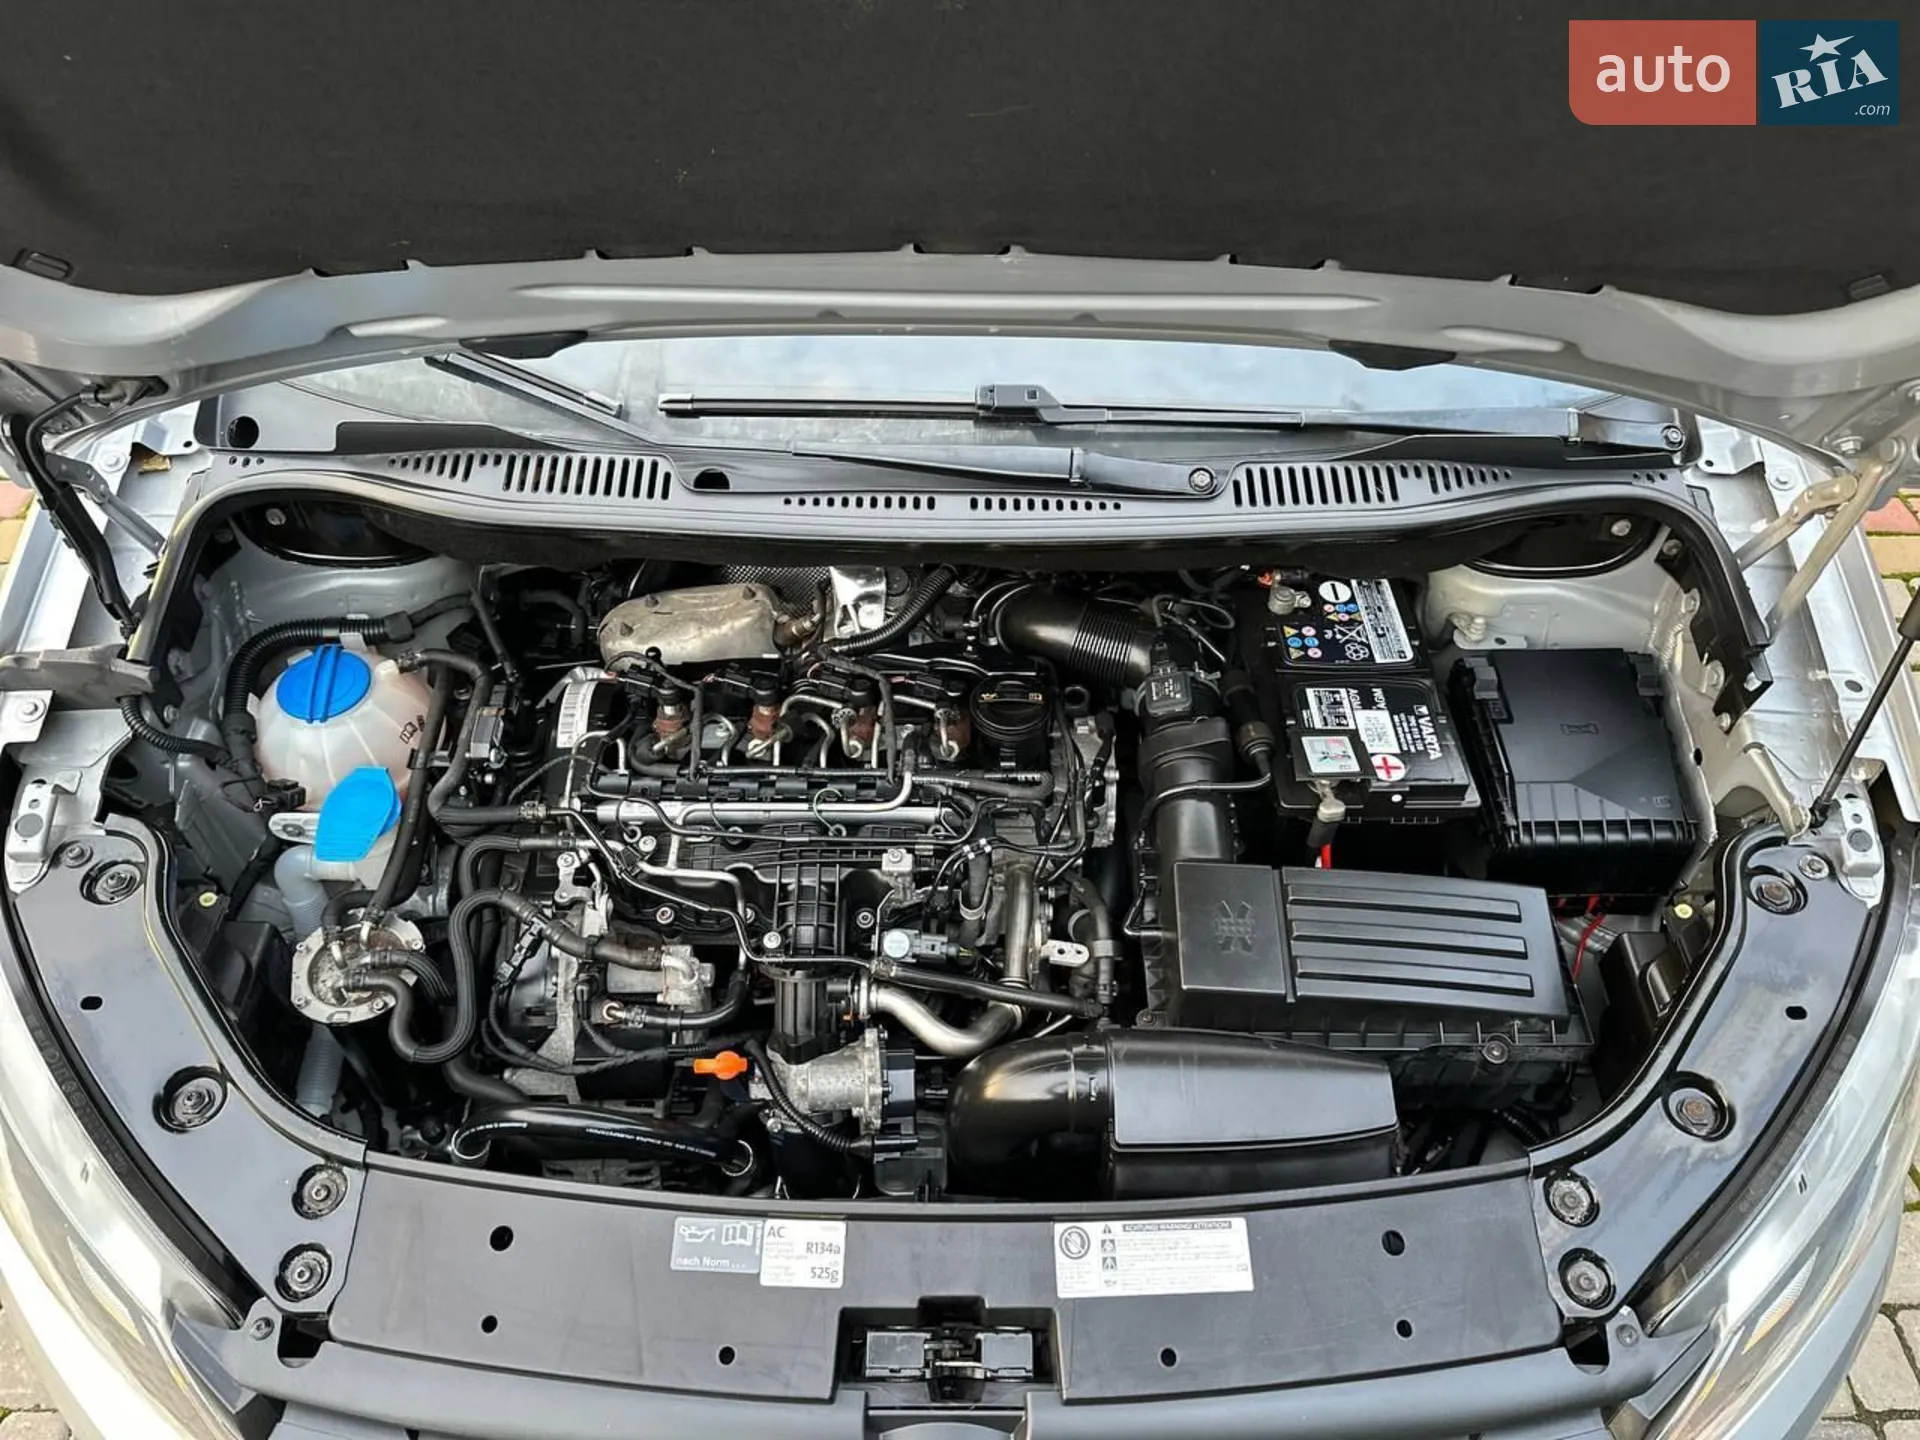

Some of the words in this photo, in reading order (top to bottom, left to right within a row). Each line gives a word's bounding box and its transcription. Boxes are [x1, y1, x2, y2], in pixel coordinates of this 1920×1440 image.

[1418, 716, 1443, 759] VARTA
[767, 1226, 786, 1239] AC
[806, 1242, 841, 1255] R134a
[676, 1257, 701, 1266] nach
[810, 1267, 840, 1283] 525g
